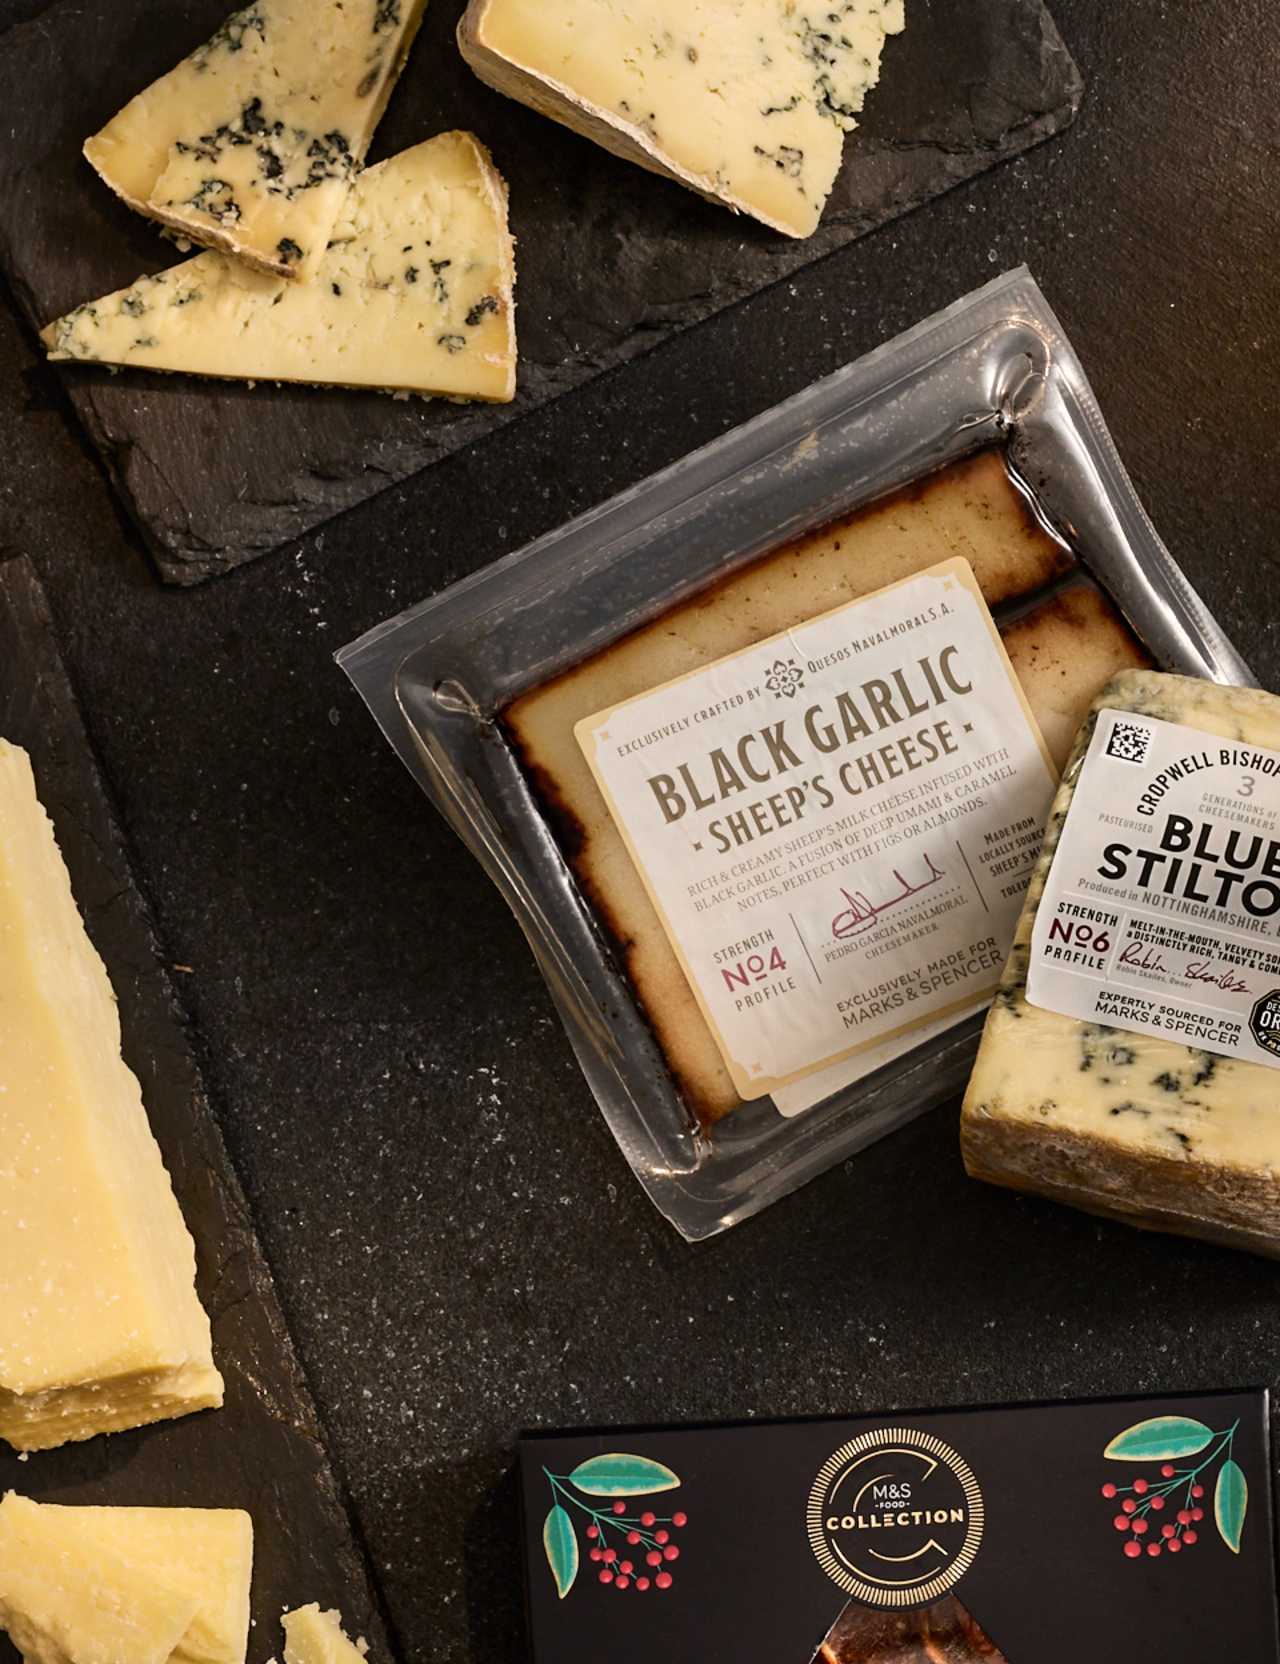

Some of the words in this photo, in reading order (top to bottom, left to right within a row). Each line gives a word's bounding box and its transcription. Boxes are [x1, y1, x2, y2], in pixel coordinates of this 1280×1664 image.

[648, 720, 804, 824] BLACK
[804, 645, 972, 753] GARLIC
[708, 775, 834, 853] SHEEP'S
[839, 721, 958, 795] CHEESE
[1136, 752, 1214, 816] CROPWELL
[1057, 902, 1119, 927] STRENGTH
[1078, 878, 1127, 898] Produced
[1128, 890, 1138, 900] in
[1142, 892, 1272, 937] NOTTINGHAMSHIRE,
[713, 929, 775, 964] STRENGTH
[1044, 945, 1106, 970] PROFILE
[735, 977, 796, 1012] PROFILE
[837, 969, 922, 1012] EXCLUSIVELY
[928, 951, 966, 973] MADE
[969, 938, 997, 955] FOR
[843, 992, 904, 1028] MARKS
[907, 987, 919, 1000] &
[919, 951, 1004, 995] SPENCER
[1094, 1002, 1149, 1024] MARKS
[1151, 1016, 1162, 1026] &
[1164, 1019, 1240, 1046] SPENCER
[1099, 991, 1155, 1010] EXPERTLY
[1159, 1006, 1214, 1027] SOURCED
[1218, 1021, 1242, 1033] FOR
[873, 1483, 911, 1500] M&S
[826, 1509, 964, 1531] COLLECTION
